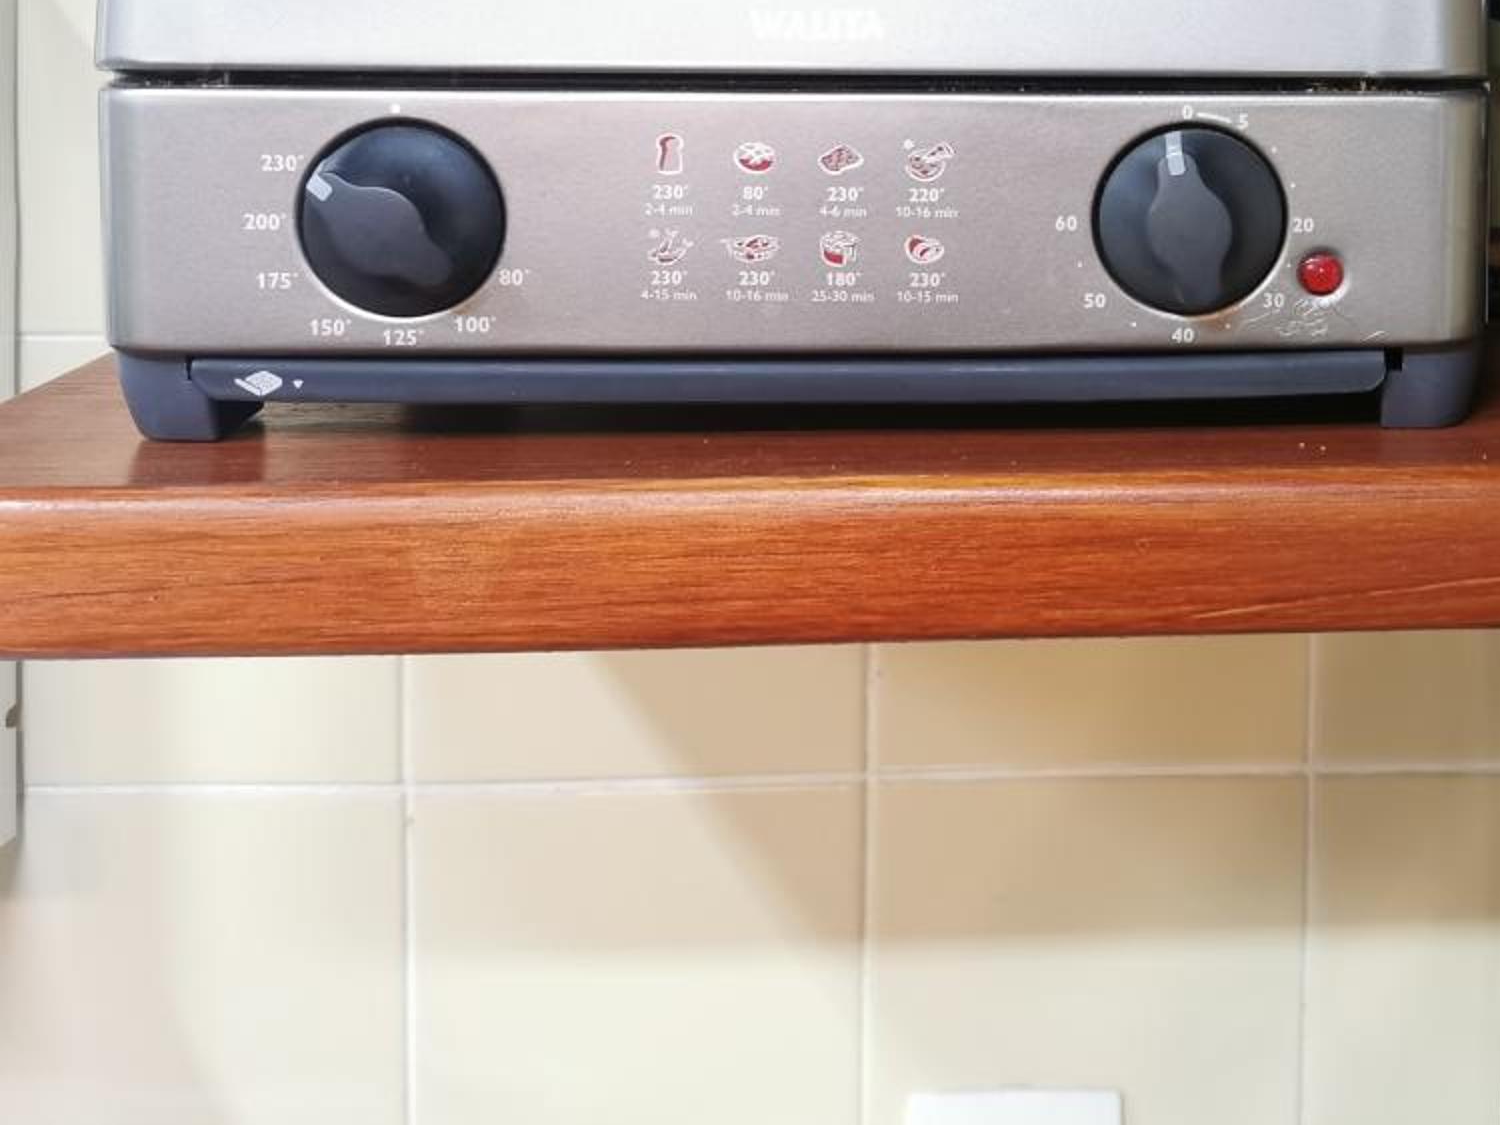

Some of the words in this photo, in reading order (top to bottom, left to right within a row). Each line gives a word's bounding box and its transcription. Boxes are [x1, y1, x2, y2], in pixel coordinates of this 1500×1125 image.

[749, 8, 884, 40] WALITA
[1182, 105, 1192, 119] 0
[261, 154, 304, 172] 230°
[653, 184, 689, 200] 230°
[826, 186, 864, 201] 230°
[908, 188, 945, 202] 220°
[669, 203, 693, 216] min
[843, 205, 867, 217] min
[935, 206, 959, 218] min
[243, 213, 287, 231] 200°
[1055, 216, 1078, 231] 60
[1293, 218, 1314, 233] 20
[256, 272, 298, 290] 175°
[651, 271, 688, 285] 230°
[739, 271, 775, 286] 230°
[910, 272, 947, 287] 230°
[673, 289, 697, 300] min
[765, 290, 789, 301] min
[851, 291, 875, 303] min
[935, 291, 959, 303] min
[1084, 293, 1106, 309] 50
[1263, 293, 1285, 309] 30
[309, 319, 351, 337] 150°
[454, 316, 497, 333] 100°
[383, 330, 424, 346] 125°
[1171, 327, 1194, 343] 40
